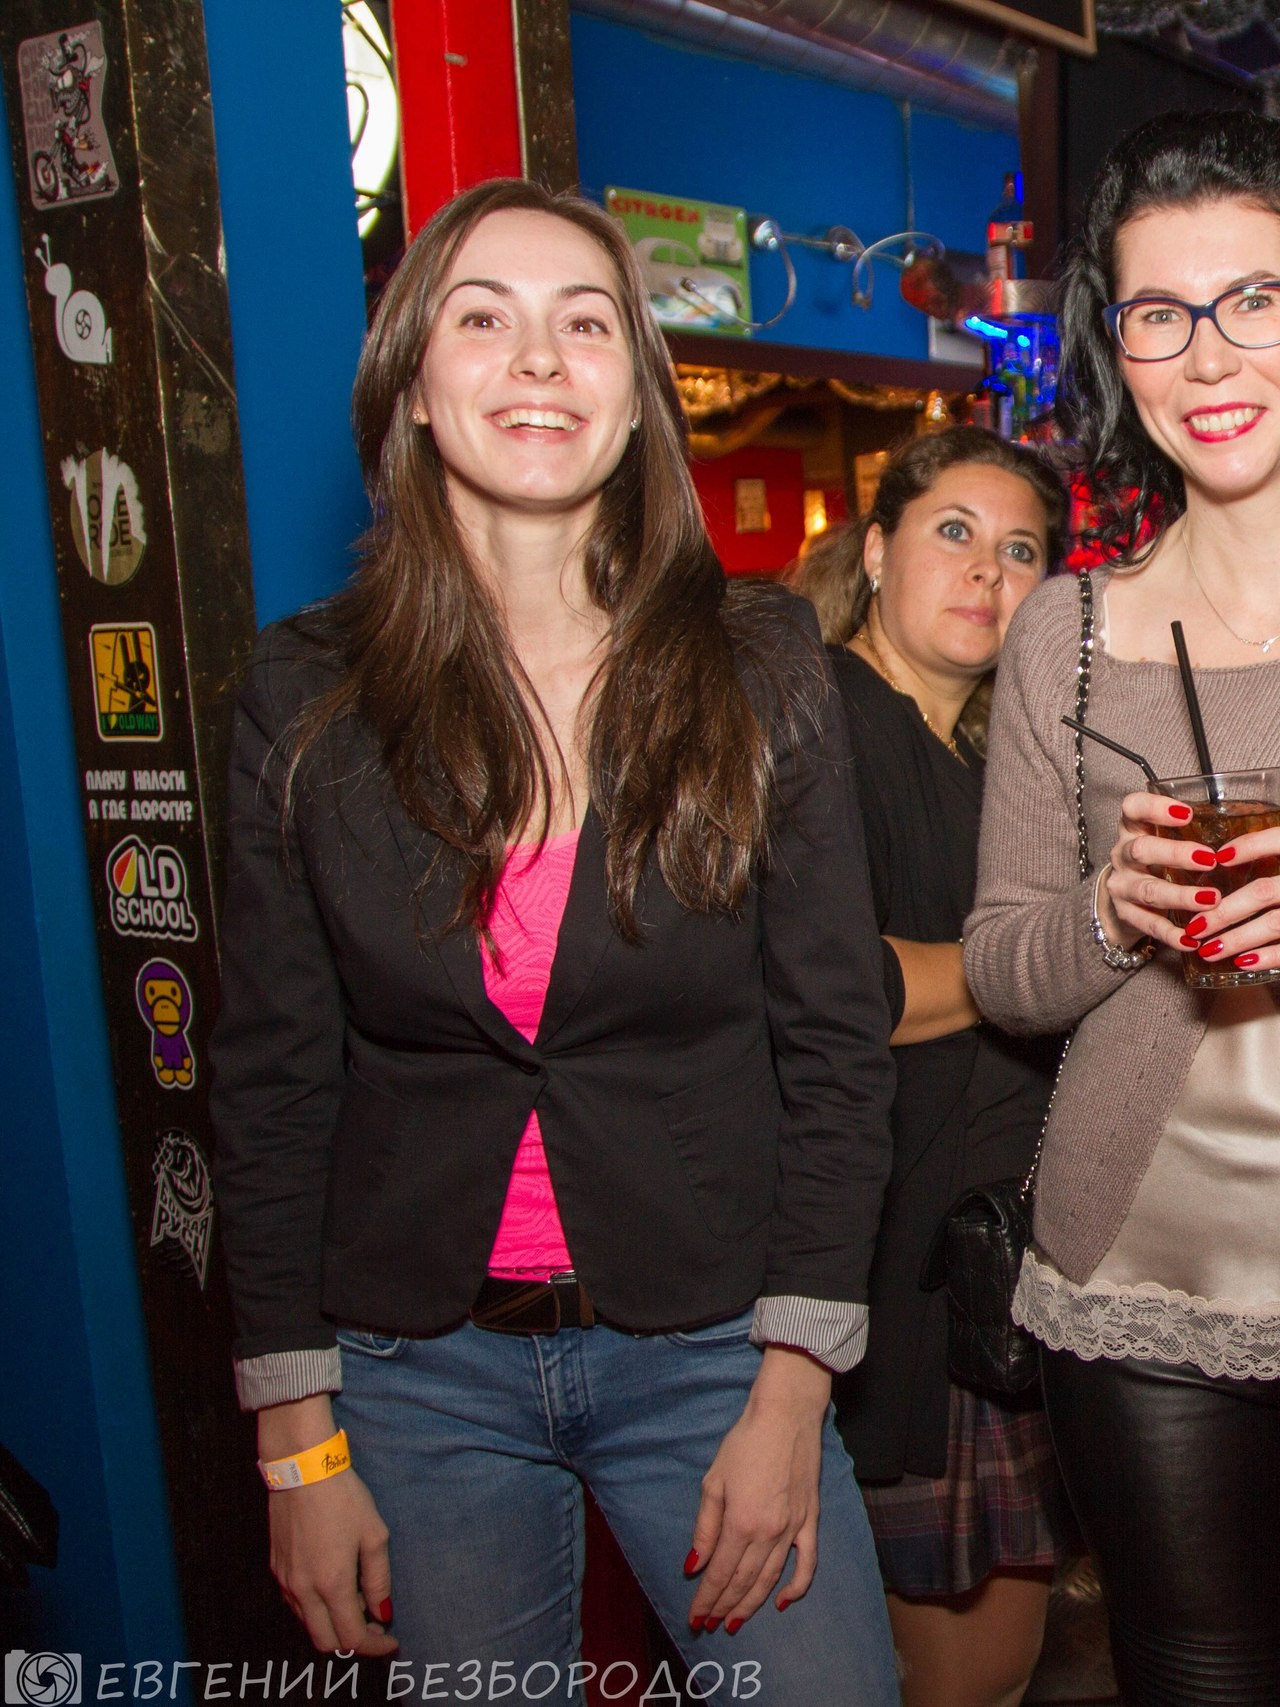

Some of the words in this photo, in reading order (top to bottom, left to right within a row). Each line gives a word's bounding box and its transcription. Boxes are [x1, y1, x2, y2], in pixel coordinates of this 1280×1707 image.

[88, 488, 129, 520] OE
[85, 770, 127, 791] ПЛАЧУ
[133, 770, 187, 792] НАЛОГИ
[130, 800, 193, 822] ДОРОГИ?
[115, 896, 193, 931] SCHOOL
